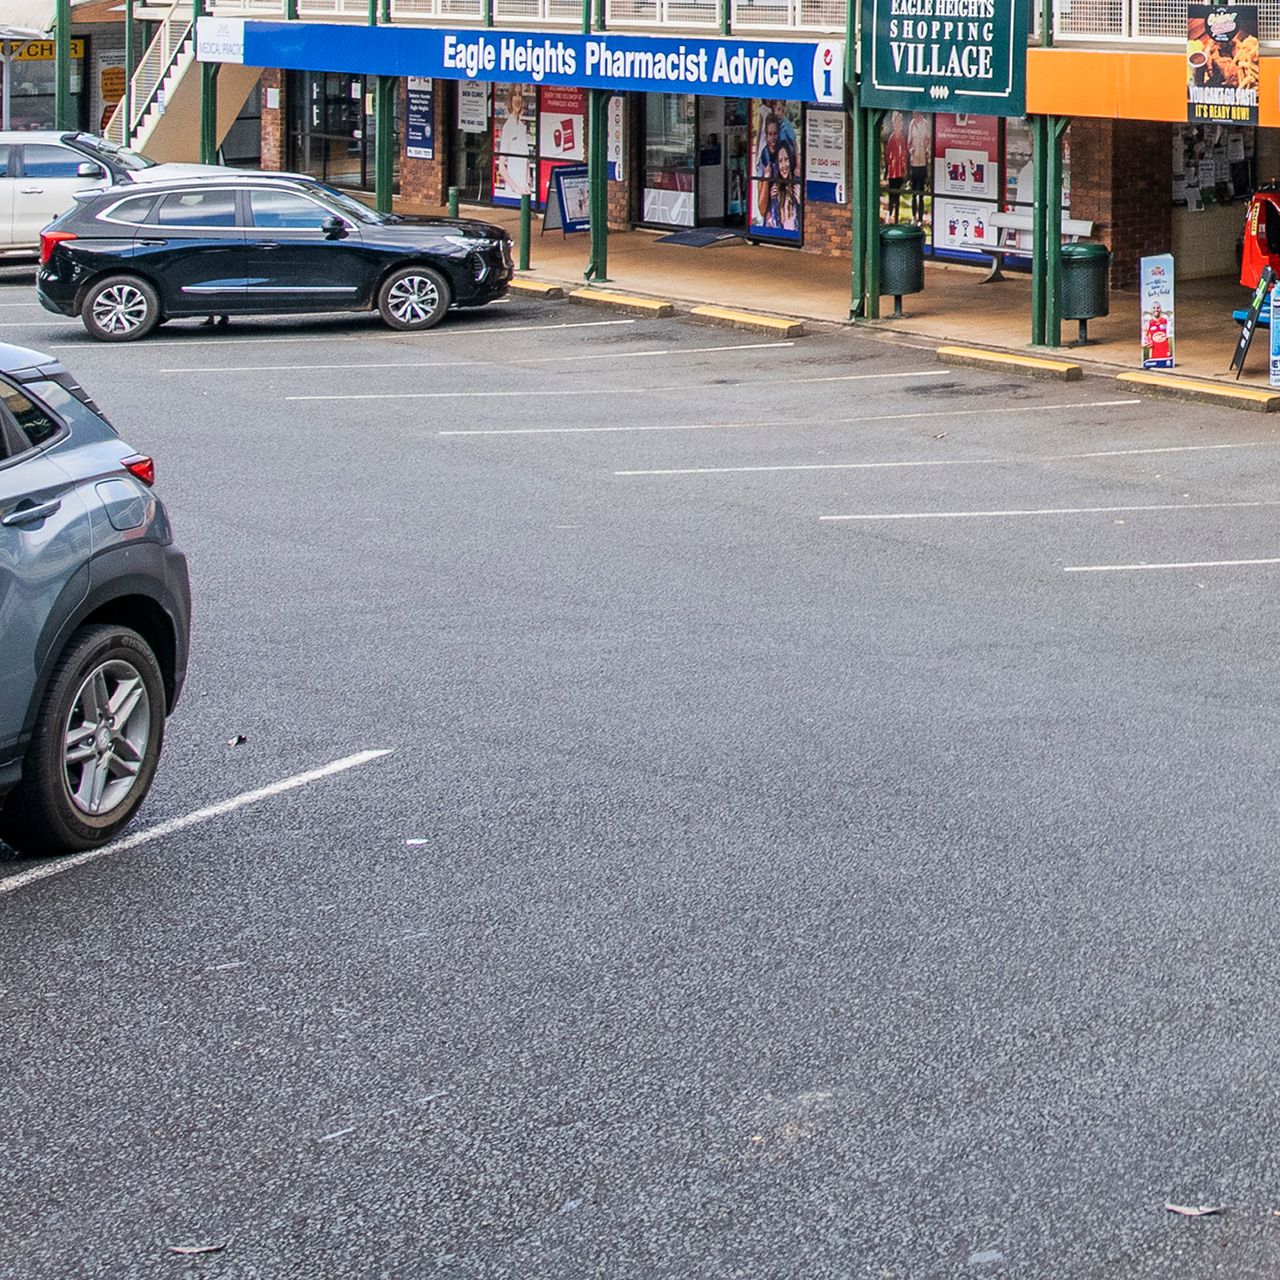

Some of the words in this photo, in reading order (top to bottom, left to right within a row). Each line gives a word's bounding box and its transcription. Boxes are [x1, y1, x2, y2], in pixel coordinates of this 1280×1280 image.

[890, 19, 994, 41] SHOPPING
[443, 36, 496, 80] Eagle
[500, 38, 576, 81] Heights
[585, 41, 708, 82] Pharmacist
[712, 47, 794, 86] Advice
[890, 41, 993, 78] VILLAGE
[1195, 105, 1208, 117] IT'S
[1209, 105, 1230, 119] READY
[1231, 106, 1250, 120] NOW!
